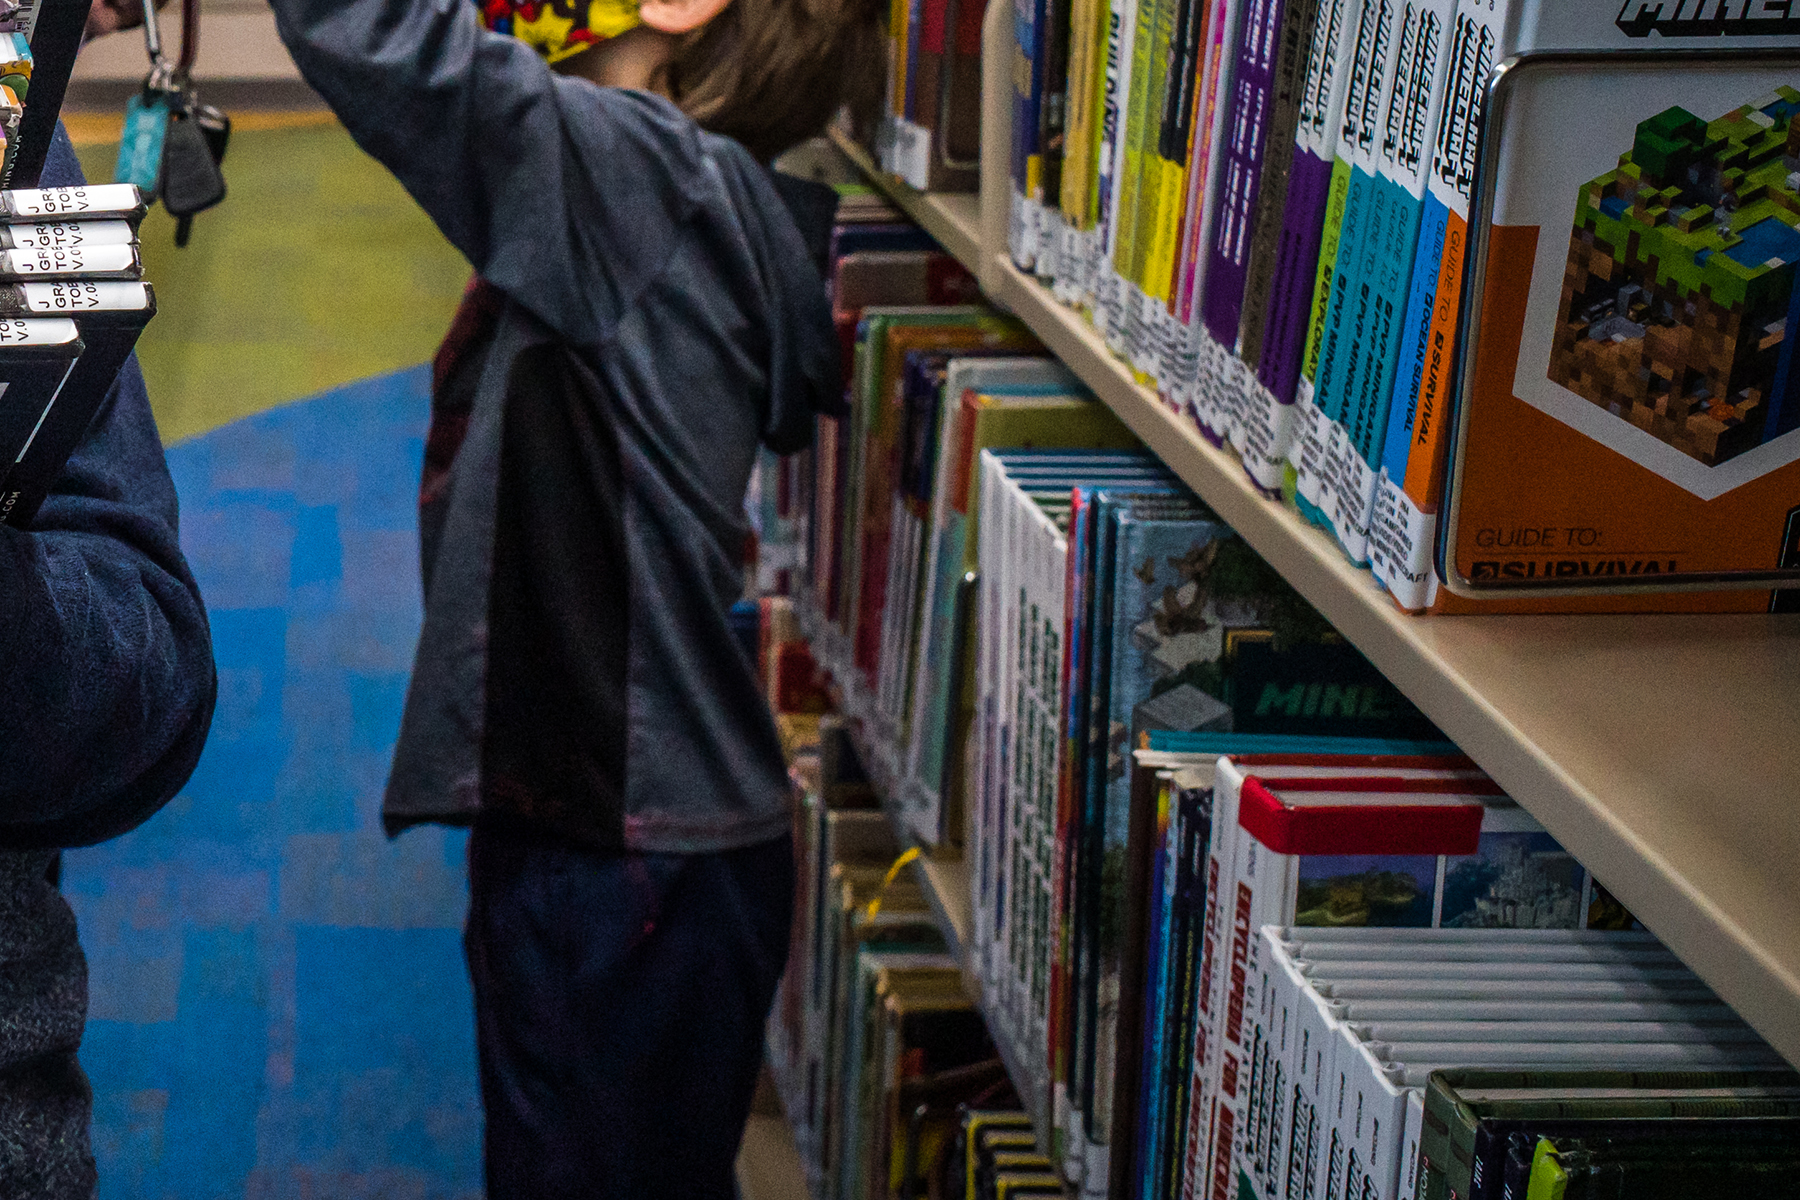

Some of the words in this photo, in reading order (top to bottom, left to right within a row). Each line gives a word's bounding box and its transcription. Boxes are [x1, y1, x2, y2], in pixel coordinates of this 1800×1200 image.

[1384, 2, 1418, 163] MINECRAFT
[1406, 11, 1442, 180] MINECRAFT
[1443, 18, 1479, 189] MINECRAFT
[1457, 24, 1495, 200] MINECRAFT
[27, 206, 40, 214] J
[22, 239, 35, 247] J
[1431, 220, 1446, 263] GUIDE
[1442, 230, 1461, 292] GUIDE
[22, 263, 35, 271] J
[38, 301, 50, 309] J
[1329, 290, 1346, 328] PVP
[1353, 299, 1369, 338] PVP
[1375, 317, 1393, 358] PVP
[1414, 308, 1432, 362] OCEAN
[1403, 364, 1422, 432] SURVIVAL
[1417, 349, 1442, 446] SURVIVAL
[1476, 527, 1557, 548] GUIDE
[1563, 527, 1602, 548] TO:
[1226, 881, 1253, 1046] ENCYCLOPEDIA
[1249, 930, 1261, 970] THE
[1238, 985, 1258, 1097] ULTIMATE
[1222, 1050, 1240, 1100] FOR
